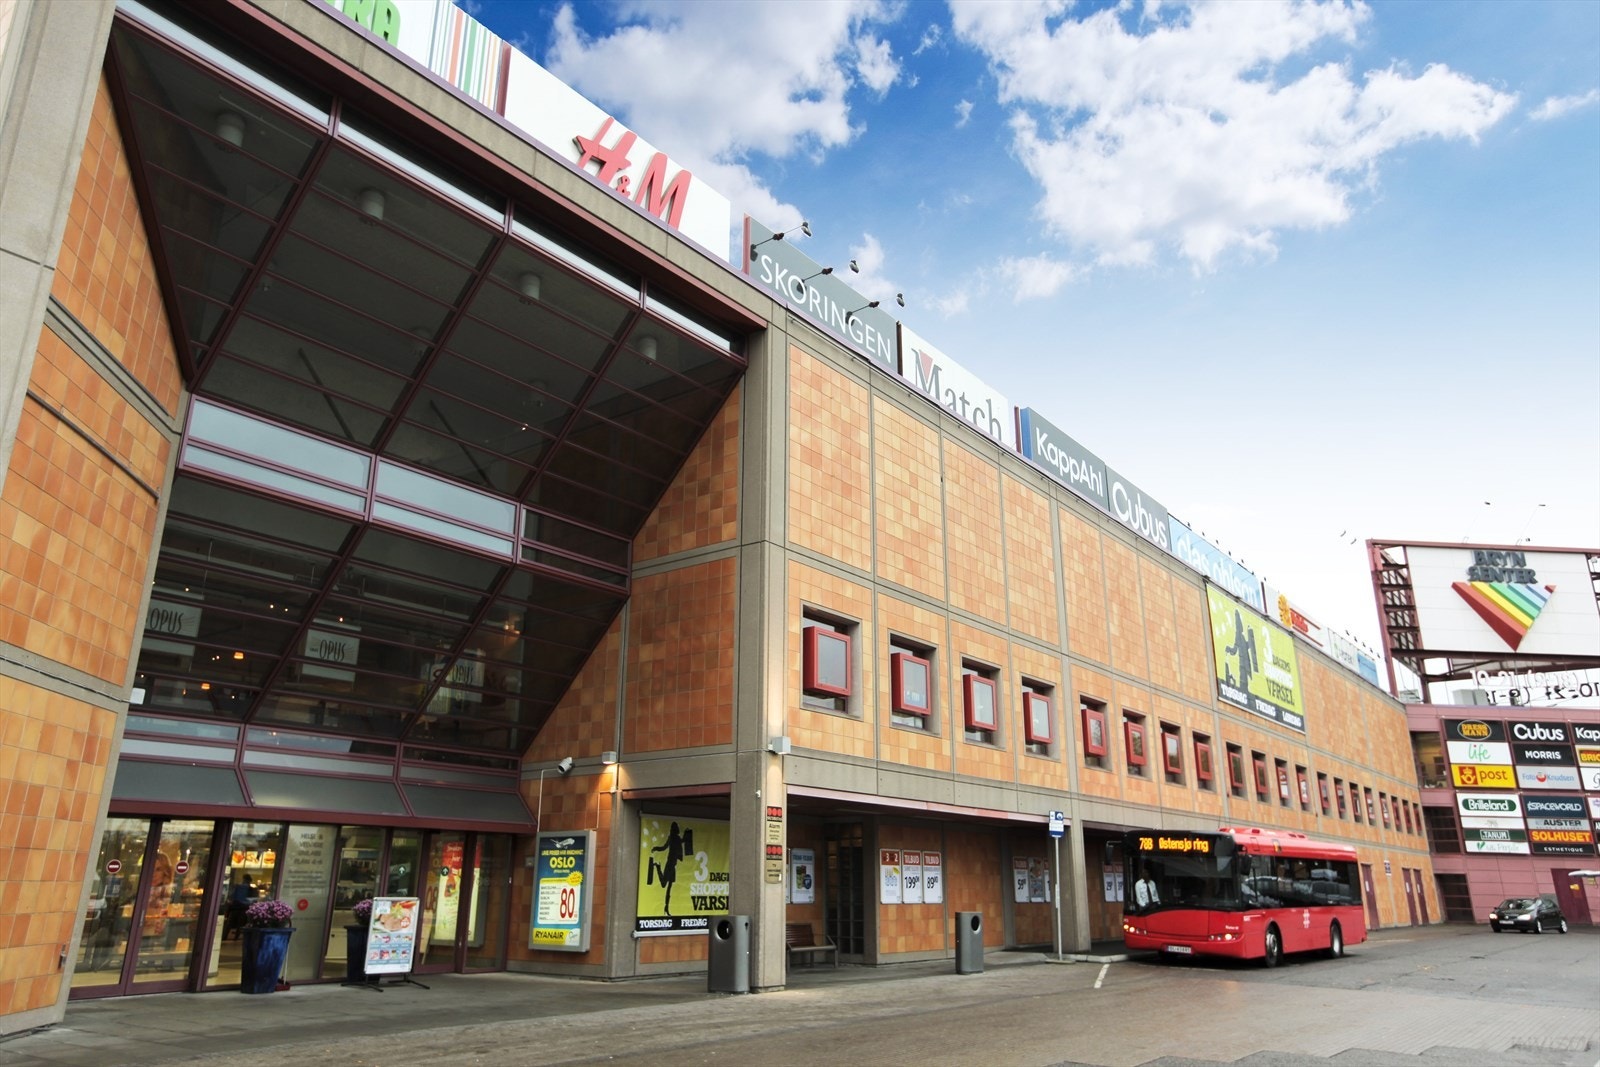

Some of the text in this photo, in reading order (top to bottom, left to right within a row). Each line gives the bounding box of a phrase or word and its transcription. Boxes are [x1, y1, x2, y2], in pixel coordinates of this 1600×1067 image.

[572, 117, 692, 230] H&M
[760, 254, 892, 363] SKORINGEN
[911, 347, 1002, 441] Match
[1035, 427, 1103, 497] KappAhl
[1112, 481, 1168, 548] Cubus
[1472, 550, 1526, 567] BRYN
[1467, 566, 1537, 584] SENTER
[150, 608, 184, 634] OPUS
[319, 639, 346, 662] OPUS
[1513, 723, 1564, 741] Cubus
[1525, 750, 1561, 760] MORRIS
[1479, 771, 1508, 783] post
[1468, 799, 1509, 811] Brilleland
[1543, 819, 1582, 827] AUSTER
[1532, 831, 1591, 842] SOLHUSET
[549, 857, 575, 869] OSLO
[694, 851, 708, 882] 3
[560, 888, 575, 919] 80
[639, 919, 707, 928] TORSDAG FREDAG
[535, 931, 564, 940] RYANAIR
